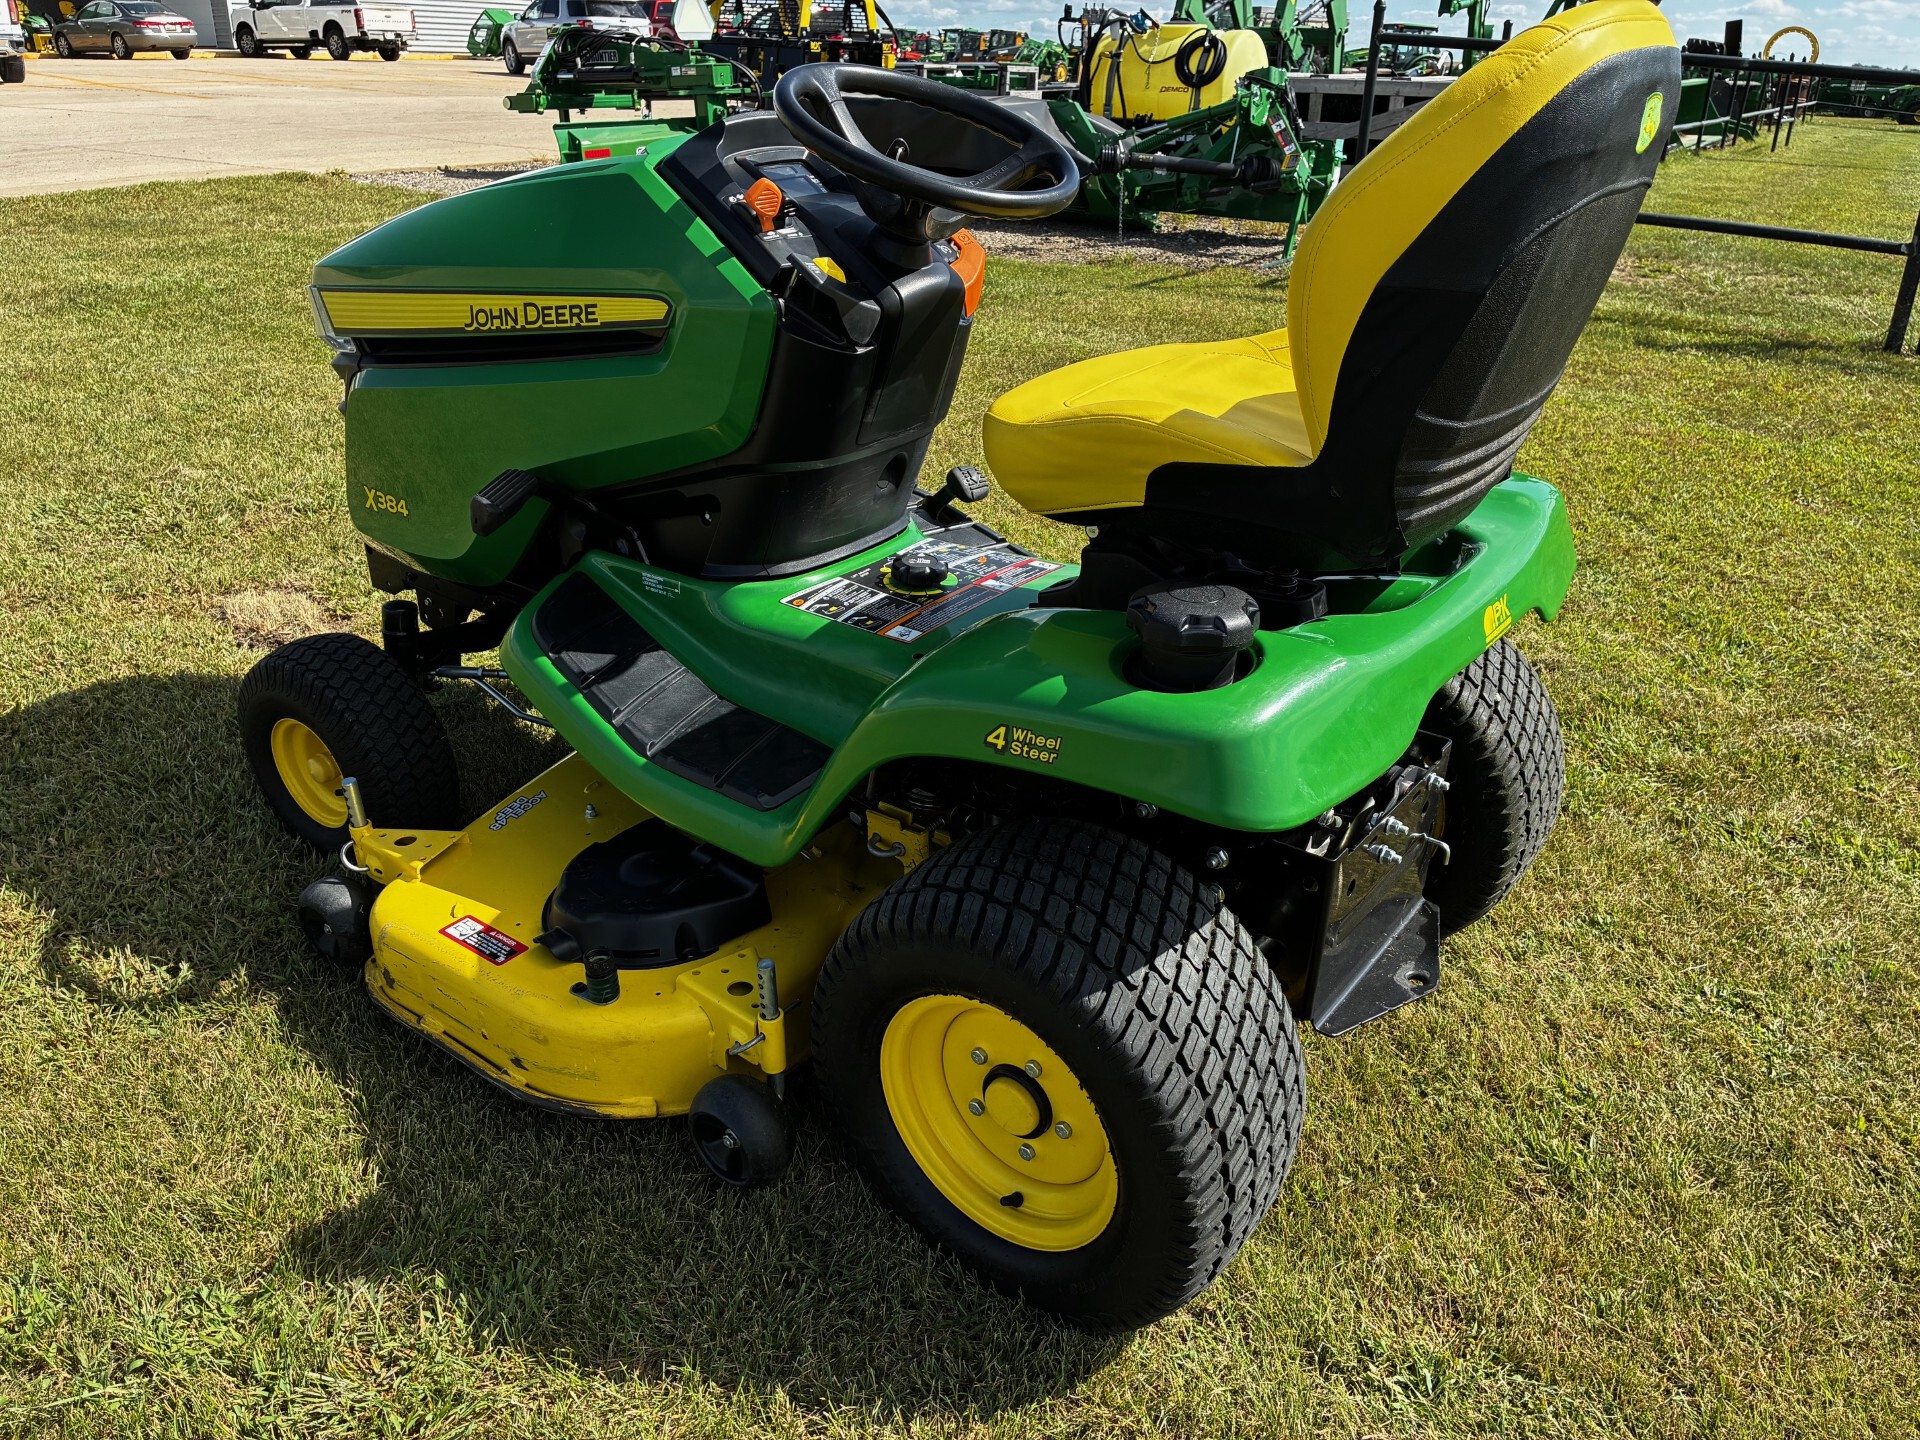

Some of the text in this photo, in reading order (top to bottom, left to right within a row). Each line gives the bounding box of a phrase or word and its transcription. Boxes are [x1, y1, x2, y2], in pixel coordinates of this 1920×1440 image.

[587, 50, 618, 63] RONTIER
[464, 302, 599, 328] JOHN DEERE
[363, 485, 409, 517] X384
[985, 724, 1062, 752] 4 Wheel
[1009, 741, 1058, 764] Steer
[495, 796, 529, 821] DEEP
[505, 790, 547, 818] ACCEL
[495, 933, 517, 947] DANGER
